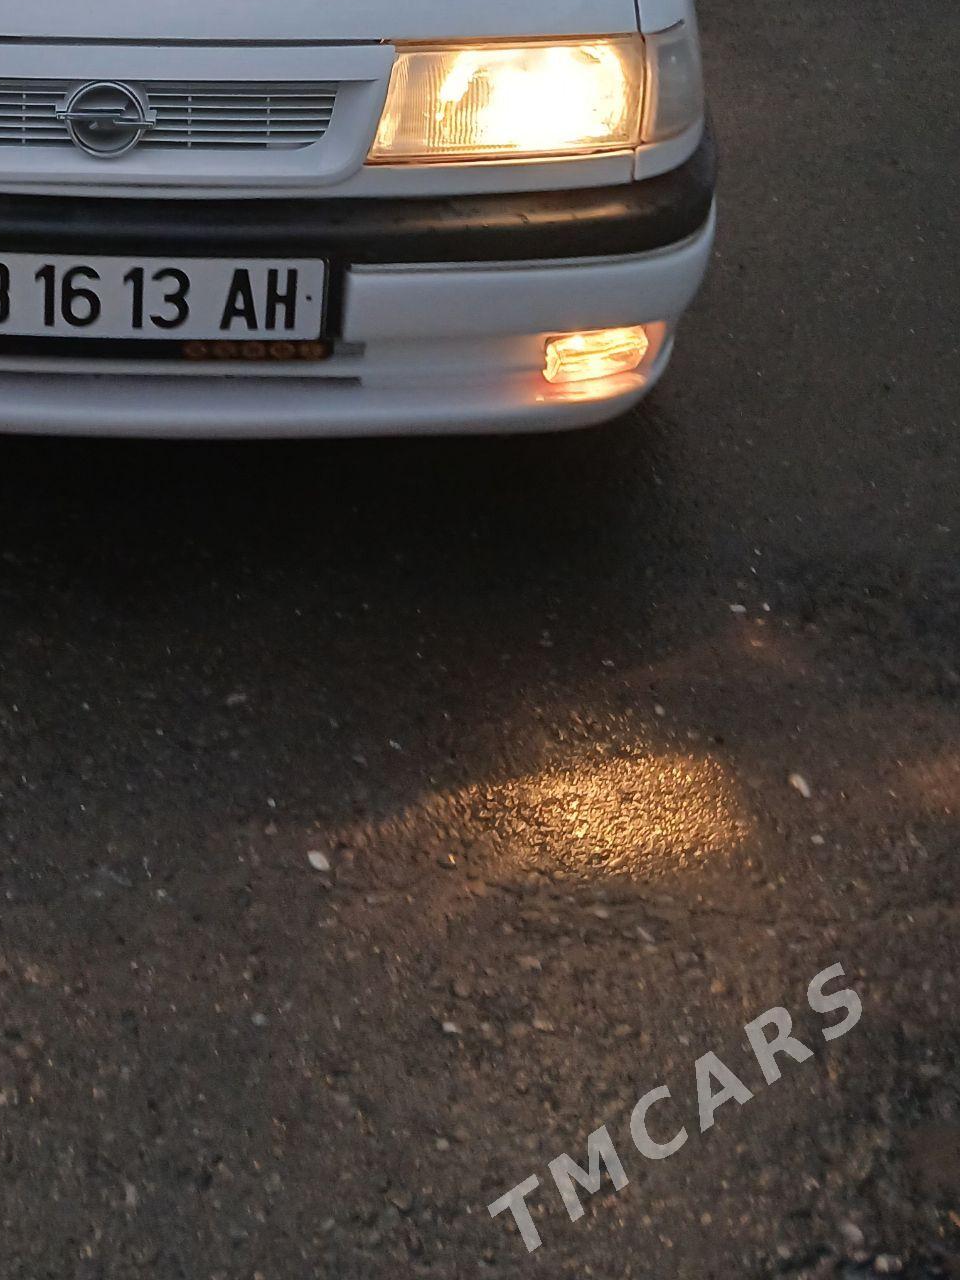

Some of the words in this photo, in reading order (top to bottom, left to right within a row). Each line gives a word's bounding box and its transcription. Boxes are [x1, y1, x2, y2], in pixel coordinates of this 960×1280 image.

[35, 264, 101, 327] 16
[123, 267, 189, 329] 13
[220, 268, 297, 330] AH
